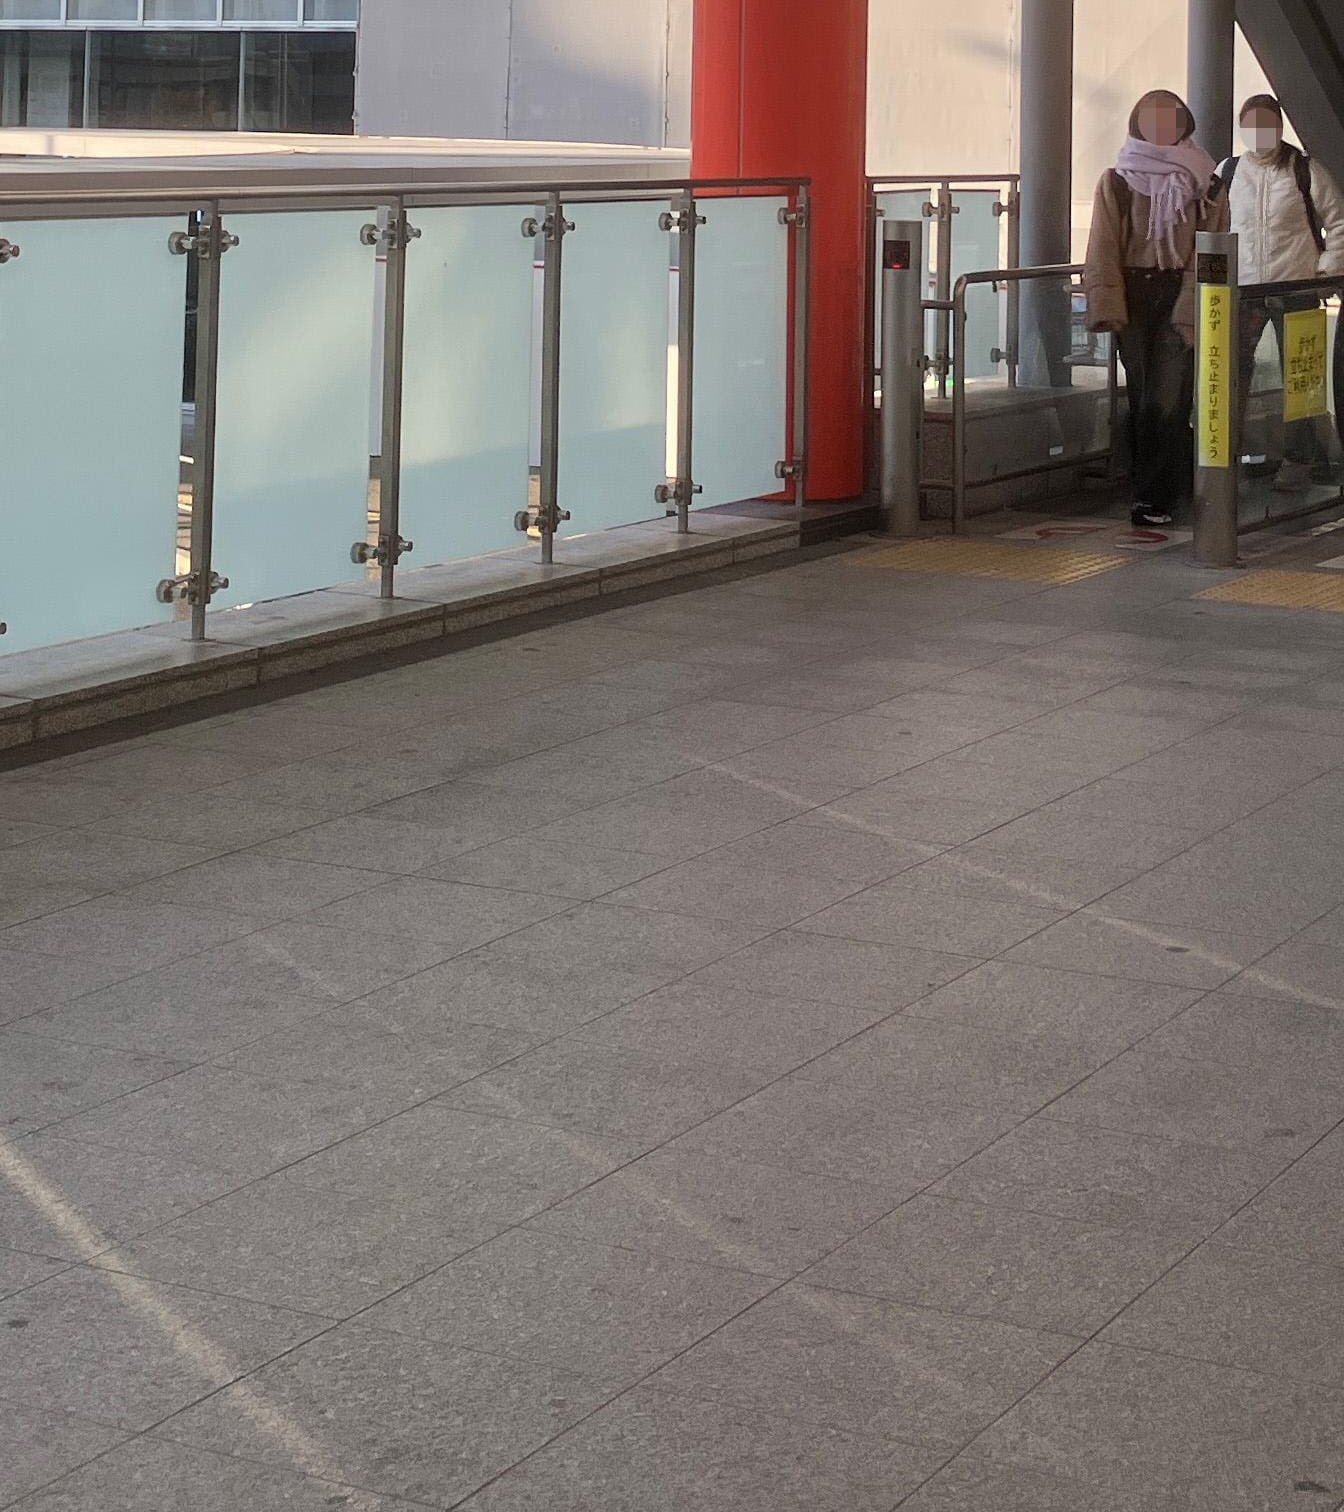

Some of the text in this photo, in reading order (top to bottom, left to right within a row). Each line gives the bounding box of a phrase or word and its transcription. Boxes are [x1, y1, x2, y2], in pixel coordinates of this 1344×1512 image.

[1208, 294, 1221, 458] 歩かず 立ち止まりましょう
